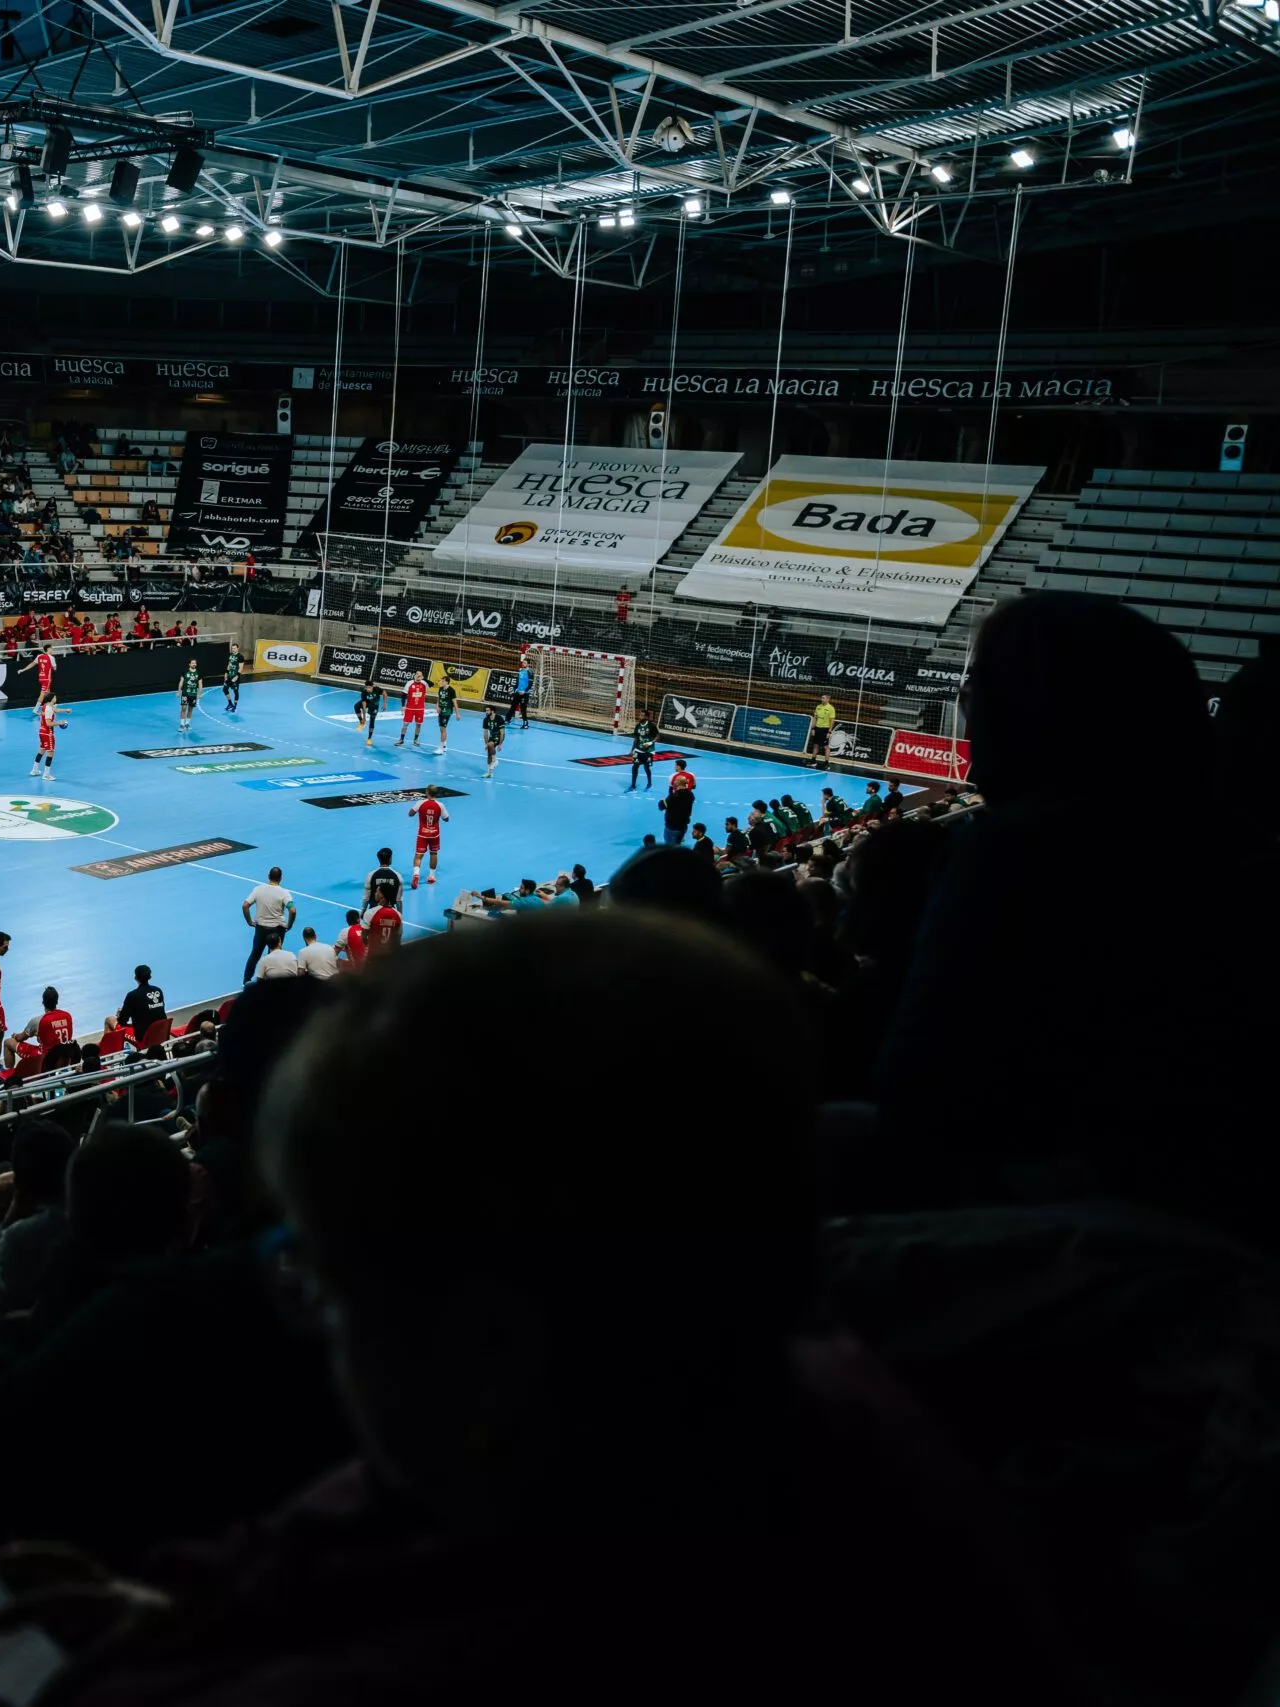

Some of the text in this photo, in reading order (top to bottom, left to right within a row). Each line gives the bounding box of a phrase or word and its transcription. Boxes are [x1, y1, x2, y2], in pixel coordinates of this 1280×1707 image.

[319, 367, 393, 380] Ayntamiento
[318, 379, 331, 390] de
[203, 513, 280, 524] abbahotels.com
[791, 501, 937, 538] Bada
[544, 528, 627, 541] DIPUTACIÓN
[539, 535, 619, 549] HUESCA
[708, 552, 963, 587] Plástico técnico & Elastómeros
[422, 608, 456, 621] MIGUEL
[267, 650, 308, 663] Bada
[769, 645, 810, 667] Aitor
[380, 666, 418, 681] escaner
[768, 661, 797, 680] Tilla
[845, 665, 895, 682] GUARA
[695, 706, 727, 719] GRACIA
[895, 742, 953, 762] avanza
[125, 842, 233, 869] ANIVERSARIO
